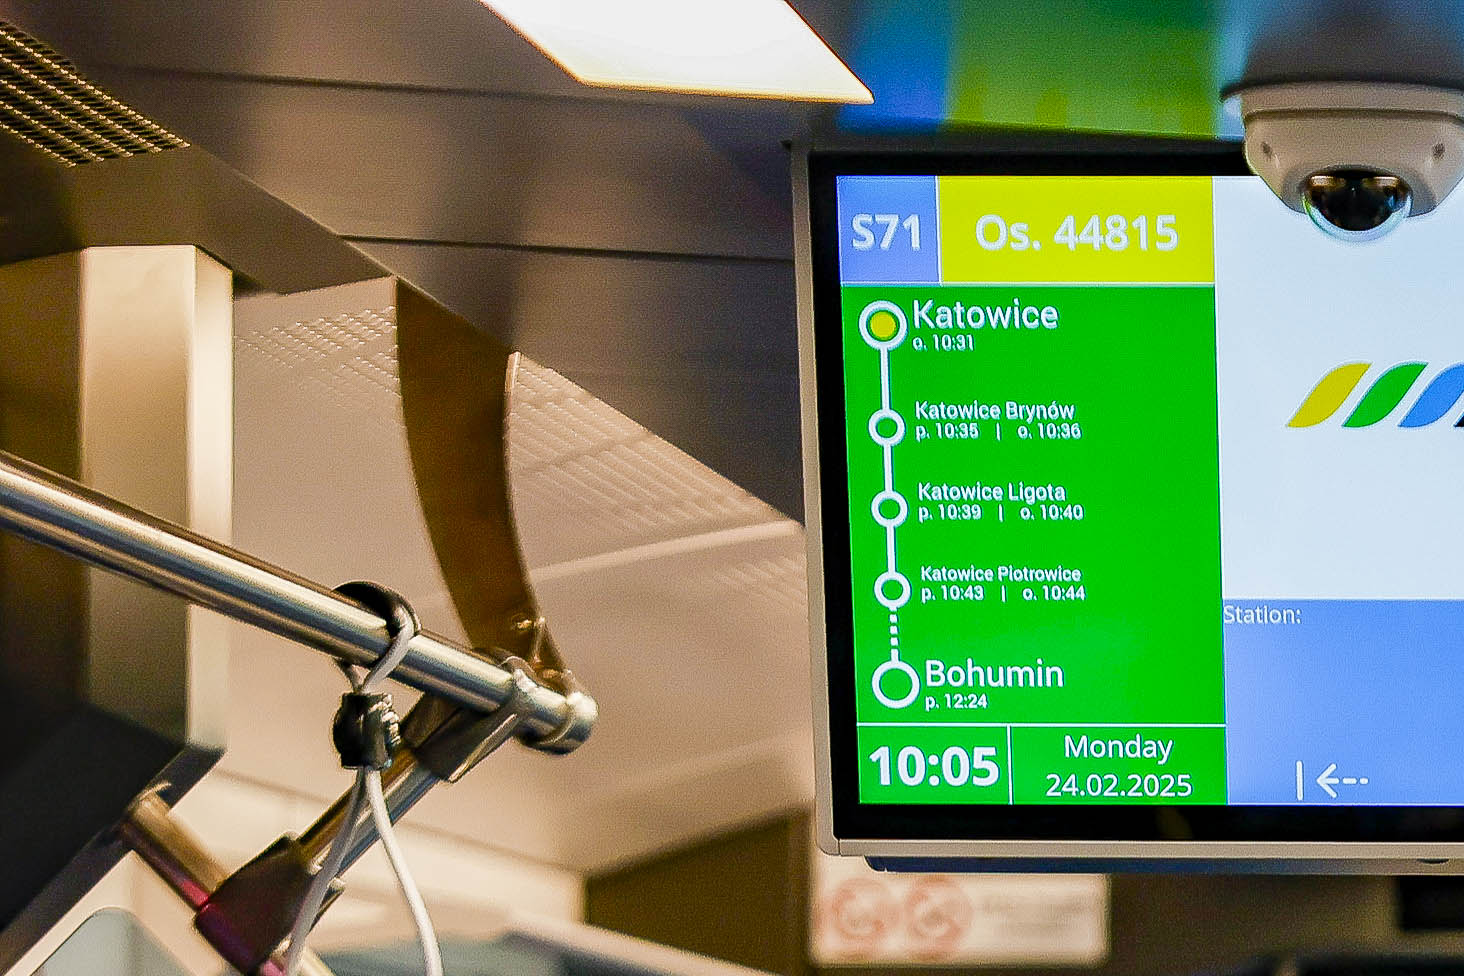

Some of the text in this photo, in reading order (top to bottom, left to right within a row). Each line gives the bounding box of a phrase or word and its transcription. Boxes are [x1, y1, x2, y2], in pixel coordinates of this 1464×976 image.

[851, 214, 921, 251] S71
[975, 214, 1179, 251] Os. 44815
[912, 298, 1059, 330] Katowice
[911, 334, 975, 351] o. 10:31
[914, 400, 1075, 424] Katowice Brynów
[914, 427, 931, 442] p.
[936, 422, 980, 440] 10:35
[1016, 426, 1034, 440] o.
[1038, 422, 1083, 440] 10:36
[917, 481, 1067, 506] Katowice Ligota
[917, 507, 934, 523] p.
[937, 504, 983, 521] 10:39
[1019, 507, 1036, 521] o.
[1039, 504, 1085, 521] 10:40
[920, 565, 1082, 582] Katowice Piotrowice
[920, 587, 937, 604] p.
[941, 585, 985, 602] 10:43
[1022, 588, 1039, 602] o.
[1042, 585, 1086, 601] 10:44
[1222, 605, 1302, 625] Station:
[925, 658, 1065, 688] Bohumin
[924, 693, 989, 710] p. 12:24
[1064, 734, 1173, 764] Monday
[868, 746, 1000, 786] 10:05
[1046, 773, 1193, 798] 24.02.2025
